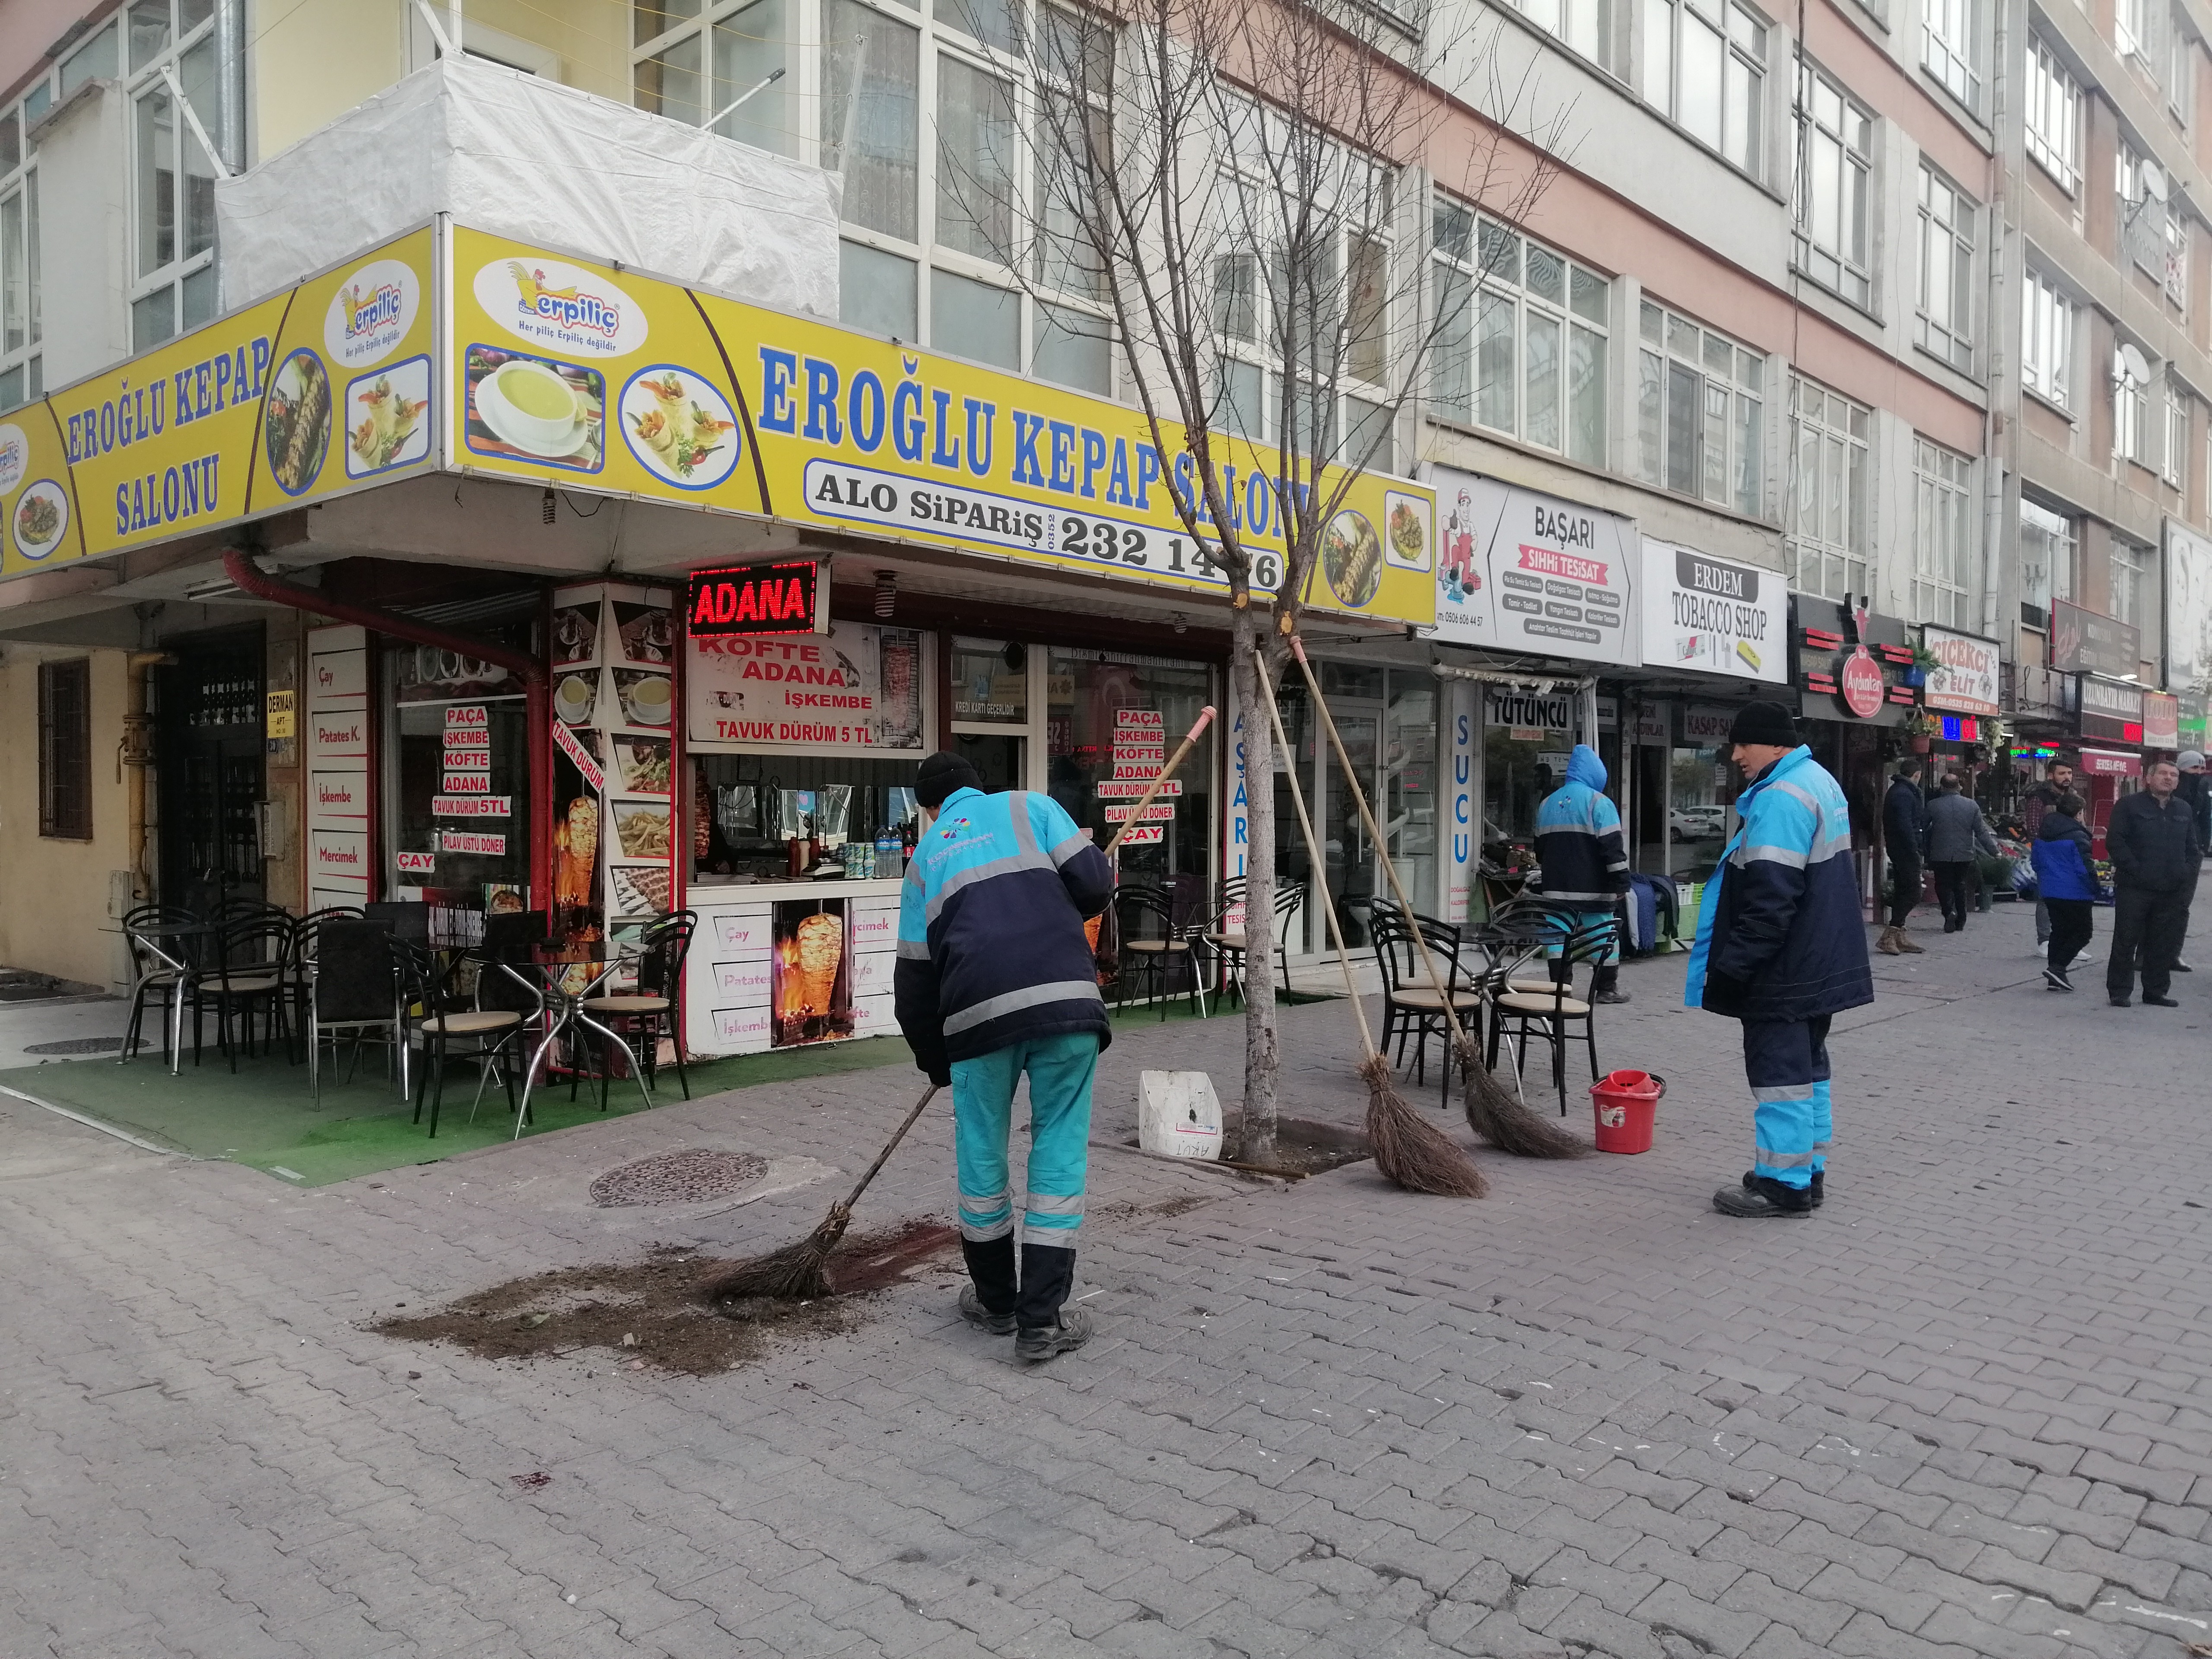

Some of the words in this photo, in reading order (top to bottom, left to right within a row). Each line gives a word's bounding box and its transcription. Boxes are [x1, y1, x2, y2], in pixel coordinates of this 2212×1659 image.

[354, 289, 400, 331] erpiliç
[538, 297, 615, 333] erpiliç
[519, 320, 533, 332] Her
[537, 326, 554, 337] piliç
[558, 329, 584, 345] Erpiliç
[587, 336, 617, 352] değildir
[355, 343, 364, 357] piliç
[366, 337, 381, 352] Erpiliç
[67, 378, 166, 466] EROĞLU
[175, 336, 270, 426] KEPAP
[757, 344, 996, 478] EROĞLU
[1011, 407, 1160, 511] KEPAP
[0, 443, 19, 466] piliç
[116, 453, 219, 536] SALONU
[816, 474, 898, 513] ALO
[1062, 518, 1147, 566] 232
[1535, 506, 1594, 550] BAŞARI
[1694, 563, 1743, 597] ERDEM
[694, 577, 805, 624] ADANA
[1445, 611, 1458, 623] 0506
[1459, 613, 1469, 625] 606
[1470, 615, 1476, 626] 44
[1477, 616, 1483, 626] 57
[1672, 591, 1732, 636] TOBACCO
[1735, 604, 1767, 641] SHOP
[319, 667, 334, 686] Çay
[742, 661, 846, 687] ADANA
[1847, 671, 1881, 701] Aydınlar
[1950, 673, 1975, 695] ELİT
[268, 693, 293, 713] DERMAN
[784, 690, 872, 709] İŞKEMBE
[955, 699, 970, 713] KREDİ
[971, 702, 985, 714] KARTI
[986, 702, 1014, 718] GEÇERLİDİR
[1964, 700, 1974, 710] 828
[1975, 702, 1983, 711] 63
[1983, 704, 1990, 712] 10
[448, 709, 485, 727] PAÇA
[1119, 712, 1162, 726] PAÇA
[1495, 691, 1567, 728] TÜTÜNCÜ
[276, 717, 285, 725] APT
[319, 727, 350, 743] Patates
[351, 725, 360, 742] K.
[444, 729, 489, 747] İŞKEMBE
[716, 720, 774, 740] TAVUK
[779, 720, 836, 742] DÜRÜM
[841, 726, 850, 743] 5
[854, 727, 872, 744] TL
[1115, 729, 1163, 744] İŞKEMBE
[269, 740, 276, 751] 30
[1116, 746, 1163, 759] KÖFTE
[445, 750, 488, 766] KÖFTE
[554, 722, 578, 759] TAVUK
[575, 749, 604, 790] DÜRÜM
[1115, 766, 1163, 778] ADANA
[445, 775, 488, 791] ADANA
[1099, 784, 1123, 796] TAVUK
[1125, 782, 1150, 796] DÜRÜM
[319, 783, 352, 806] İşkembe
[433, 799, 454, 814] TAVUK
[456, 798, 478, 814] DÜRÜM
[1107, 806, 1127, 821] PİLAV
[1149, 804, 1173, 818] DÖNER
[444, 832, 461, 850] PİLAV
[463, 834, 480, 852] ÜSTÜ
[481, 835, 504, 854] DÖNER
[1123, 828, 1163, 843] ÇAY
[320, 846, 358, 864] Mercimek
[398, 854, 434, 870] ÇAY
[725, 927, 750, 943] Çay
